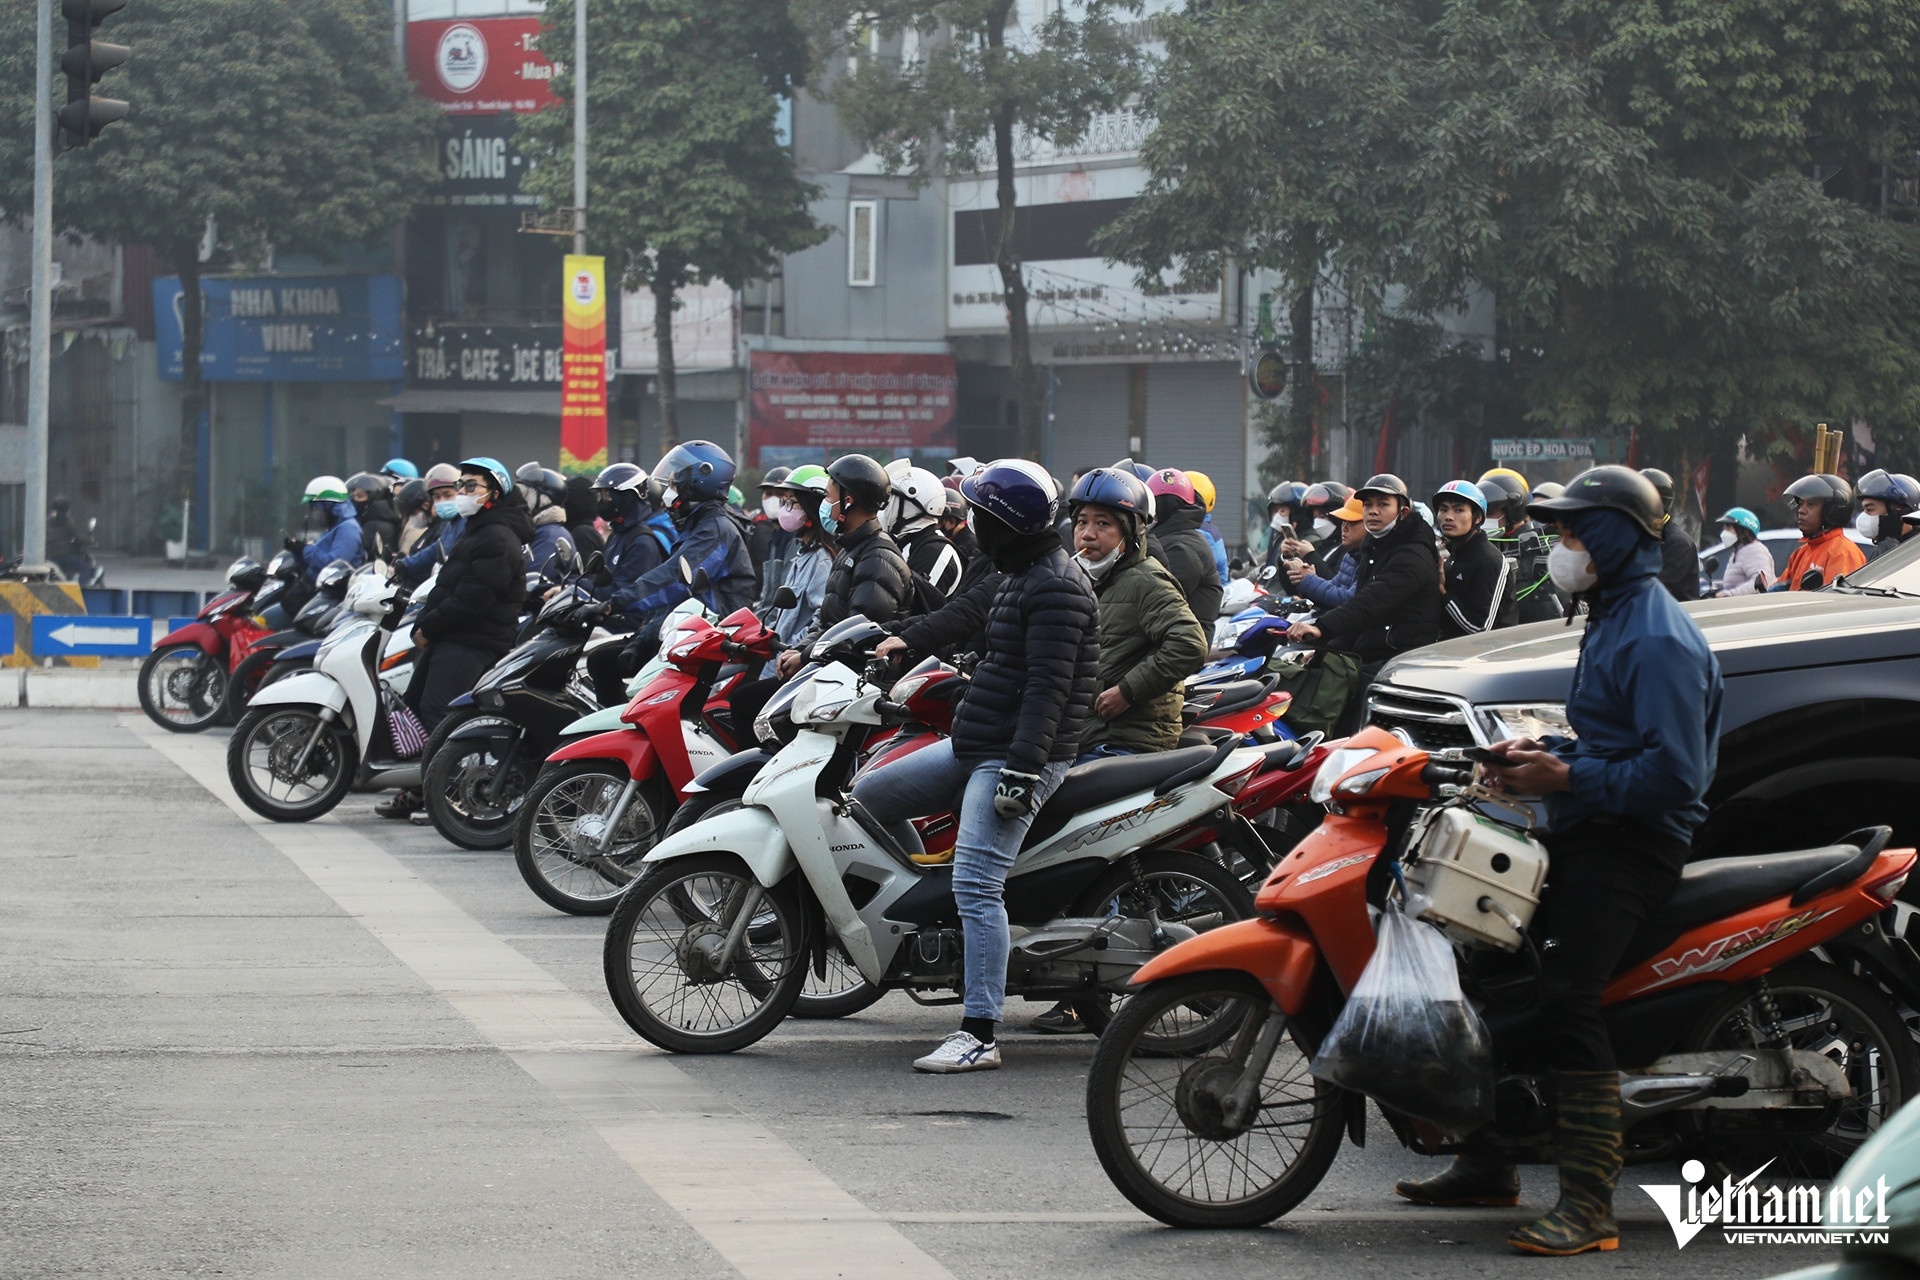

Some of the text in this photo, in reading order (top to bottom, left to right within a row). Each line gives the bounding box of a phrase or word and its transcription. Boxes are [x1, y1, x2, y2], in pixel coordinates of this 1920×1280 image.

[522, 62, 552, 80] Mua
[446, 129, 506, 179] SÁNG
[230, 287, 341, 317] NHA KHOA
[461, 348, 500, 381] CAFE
[1492, 441, 1524, 456] NƯỚC
[1543, 443, 1567, 456] HOA
[828, 842, 865, 853] HONDA
